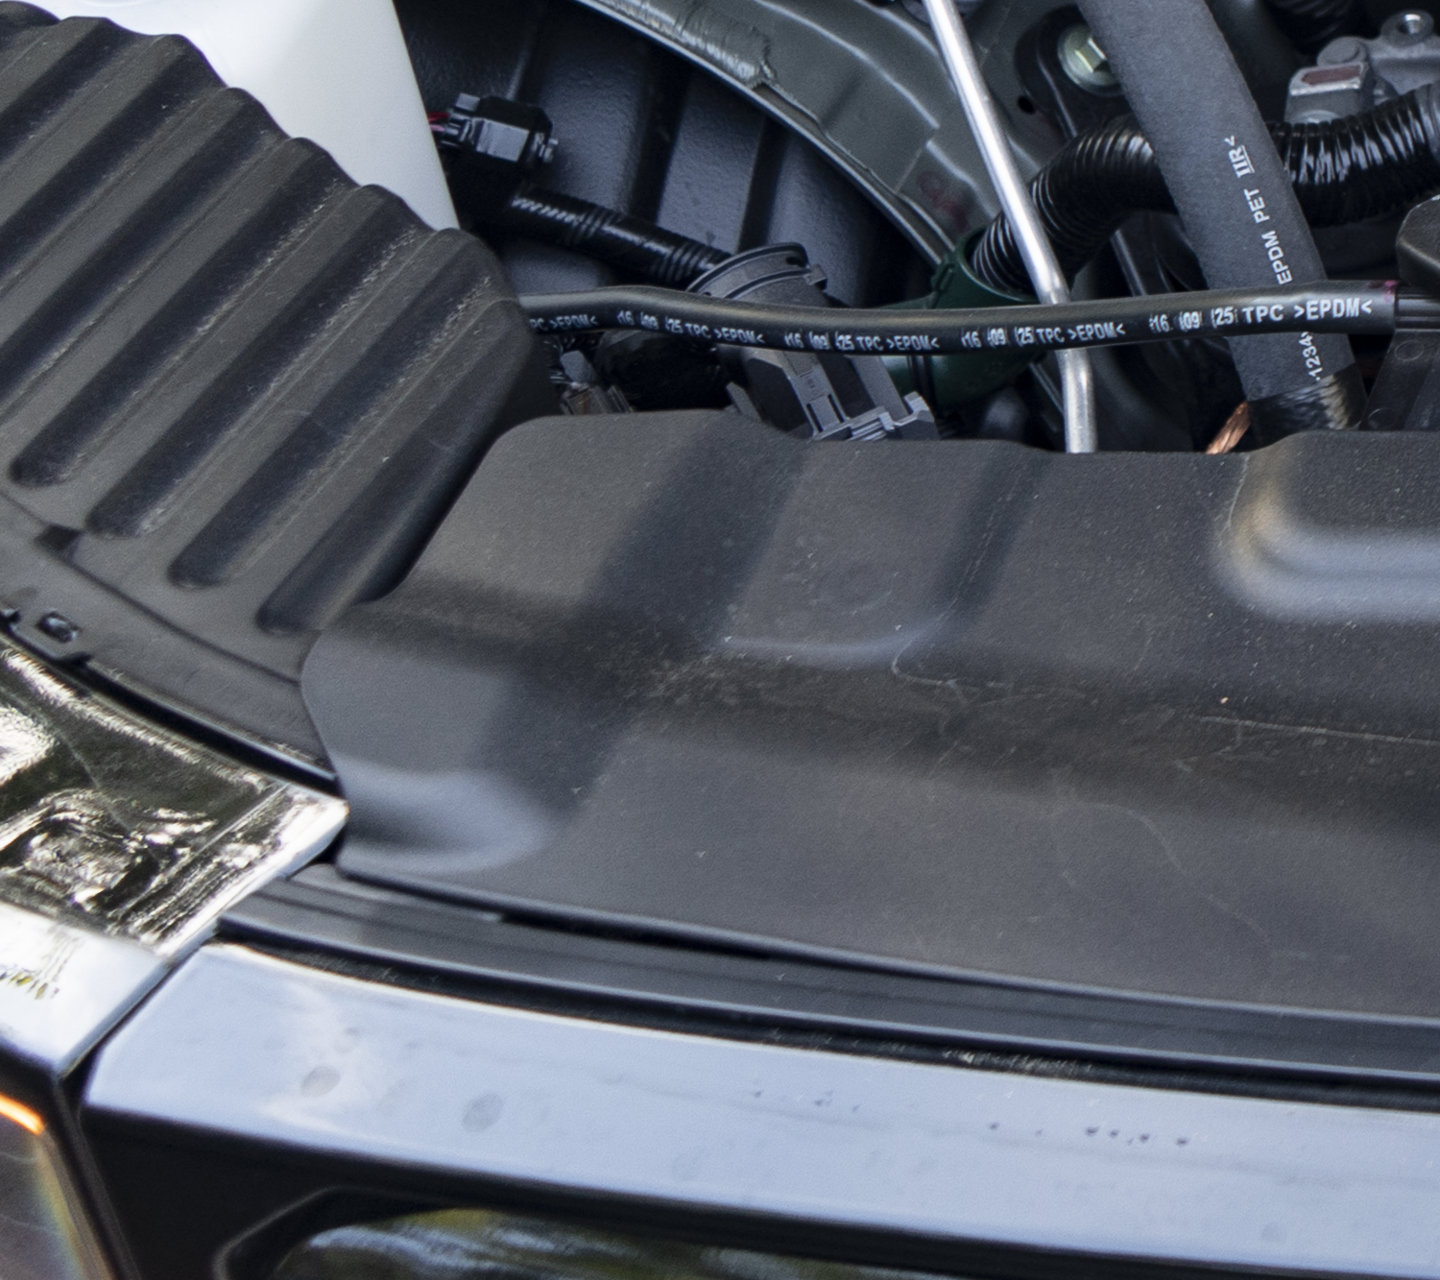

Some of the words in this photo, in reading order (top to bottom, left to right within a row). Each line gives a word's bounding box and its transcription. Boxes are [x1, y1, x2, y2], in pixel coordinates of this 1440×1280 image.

[1243, 188, 1270, 224] PET
[1261, 229, 1293, 285] EPDM
[685, 322, 712, 339] TPC
[856, 335, 884, 351] TPC
[1036, 326, 1065, 344] TPC
[1242, 304, 1285, 324] TPC
